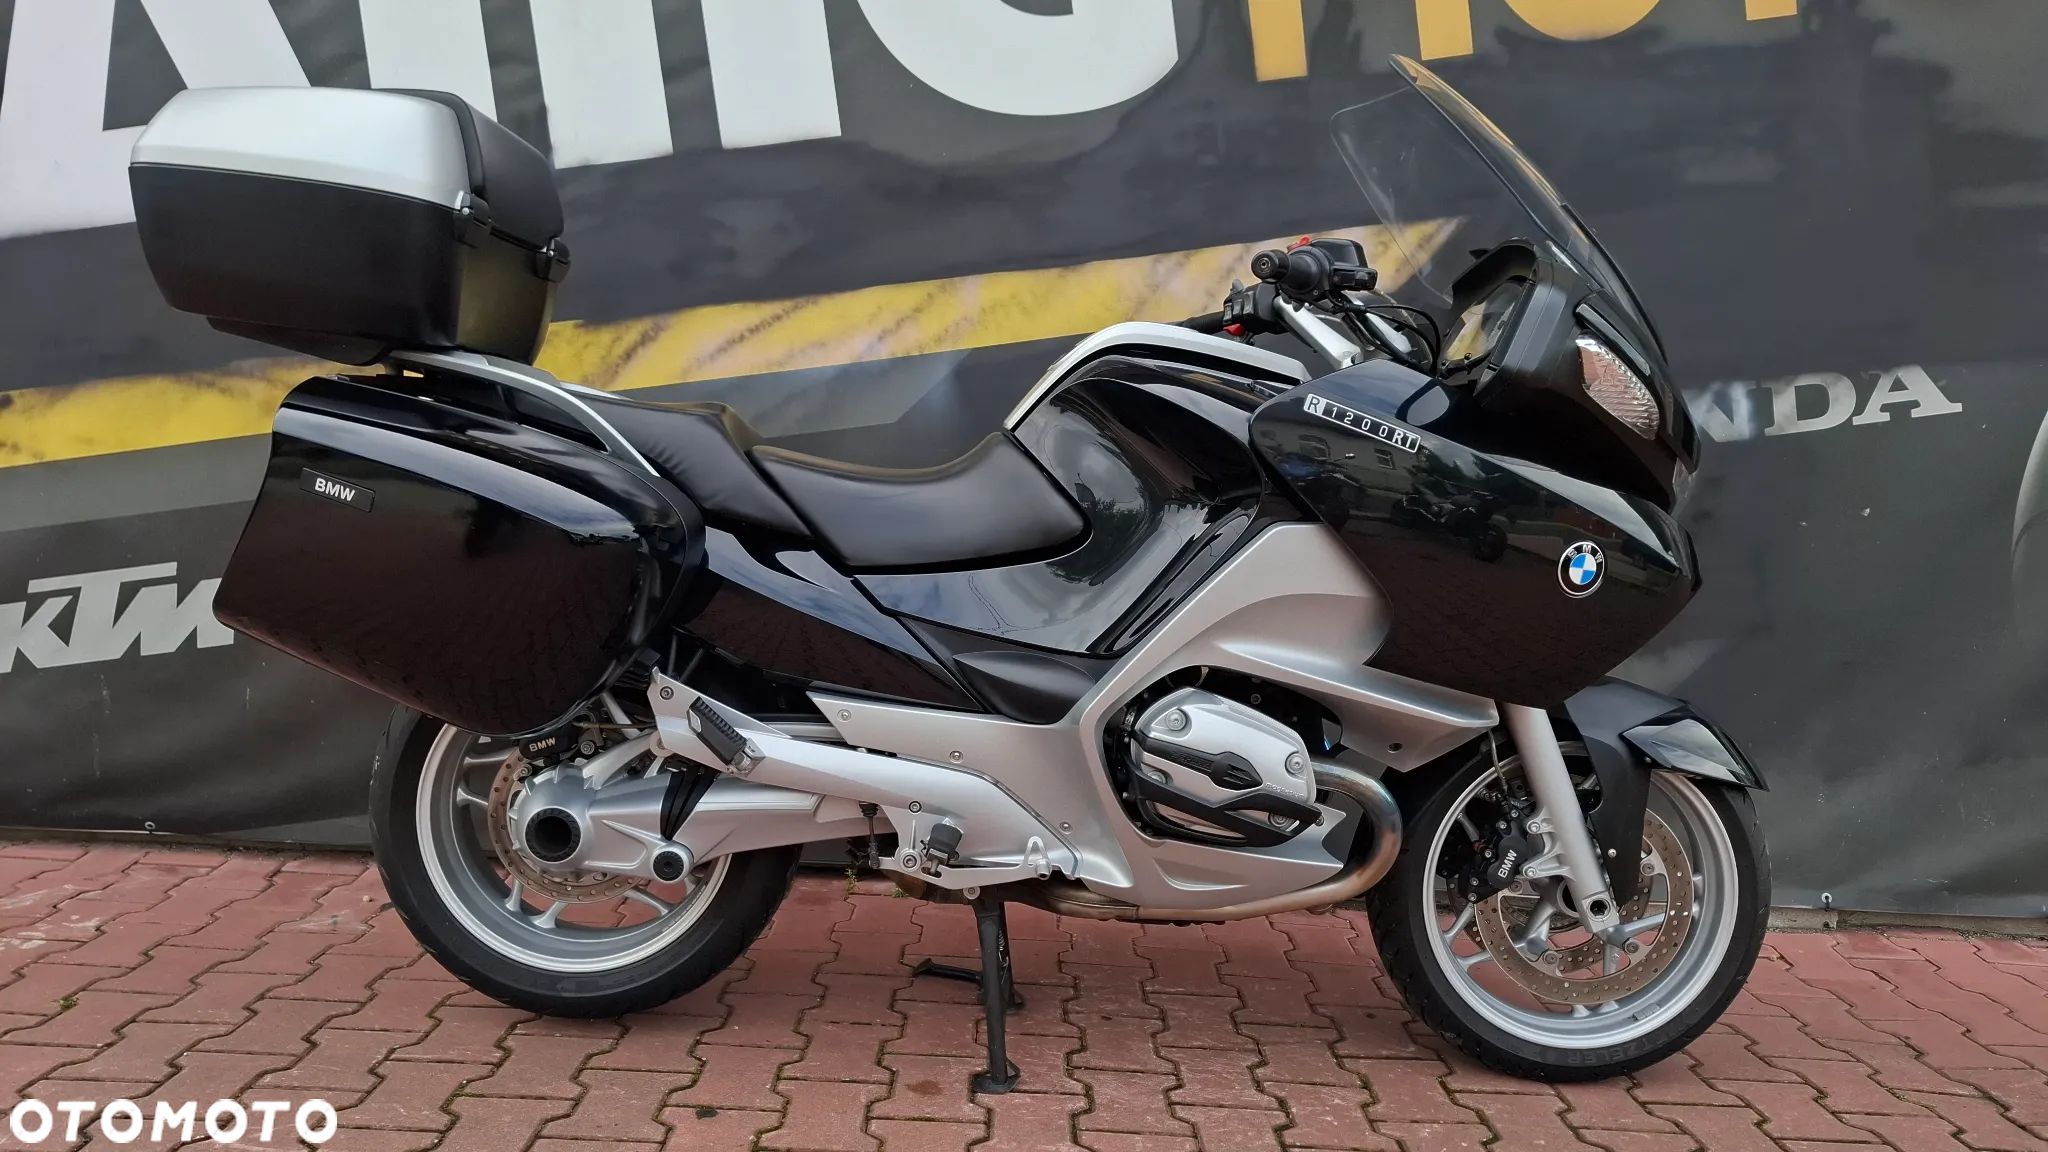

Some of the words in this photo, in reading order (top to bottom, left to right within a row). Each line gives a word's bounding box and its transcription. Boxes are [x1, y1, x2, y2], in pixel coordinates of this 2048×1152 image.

[314, 477, 356, 502] BMW
[1567, 543, 1603, 563] BMW
[0, 561, 235, 674] KTM
[528, 736, 557, 752] BMW
[1497, 849, 1518, 879] BMW
